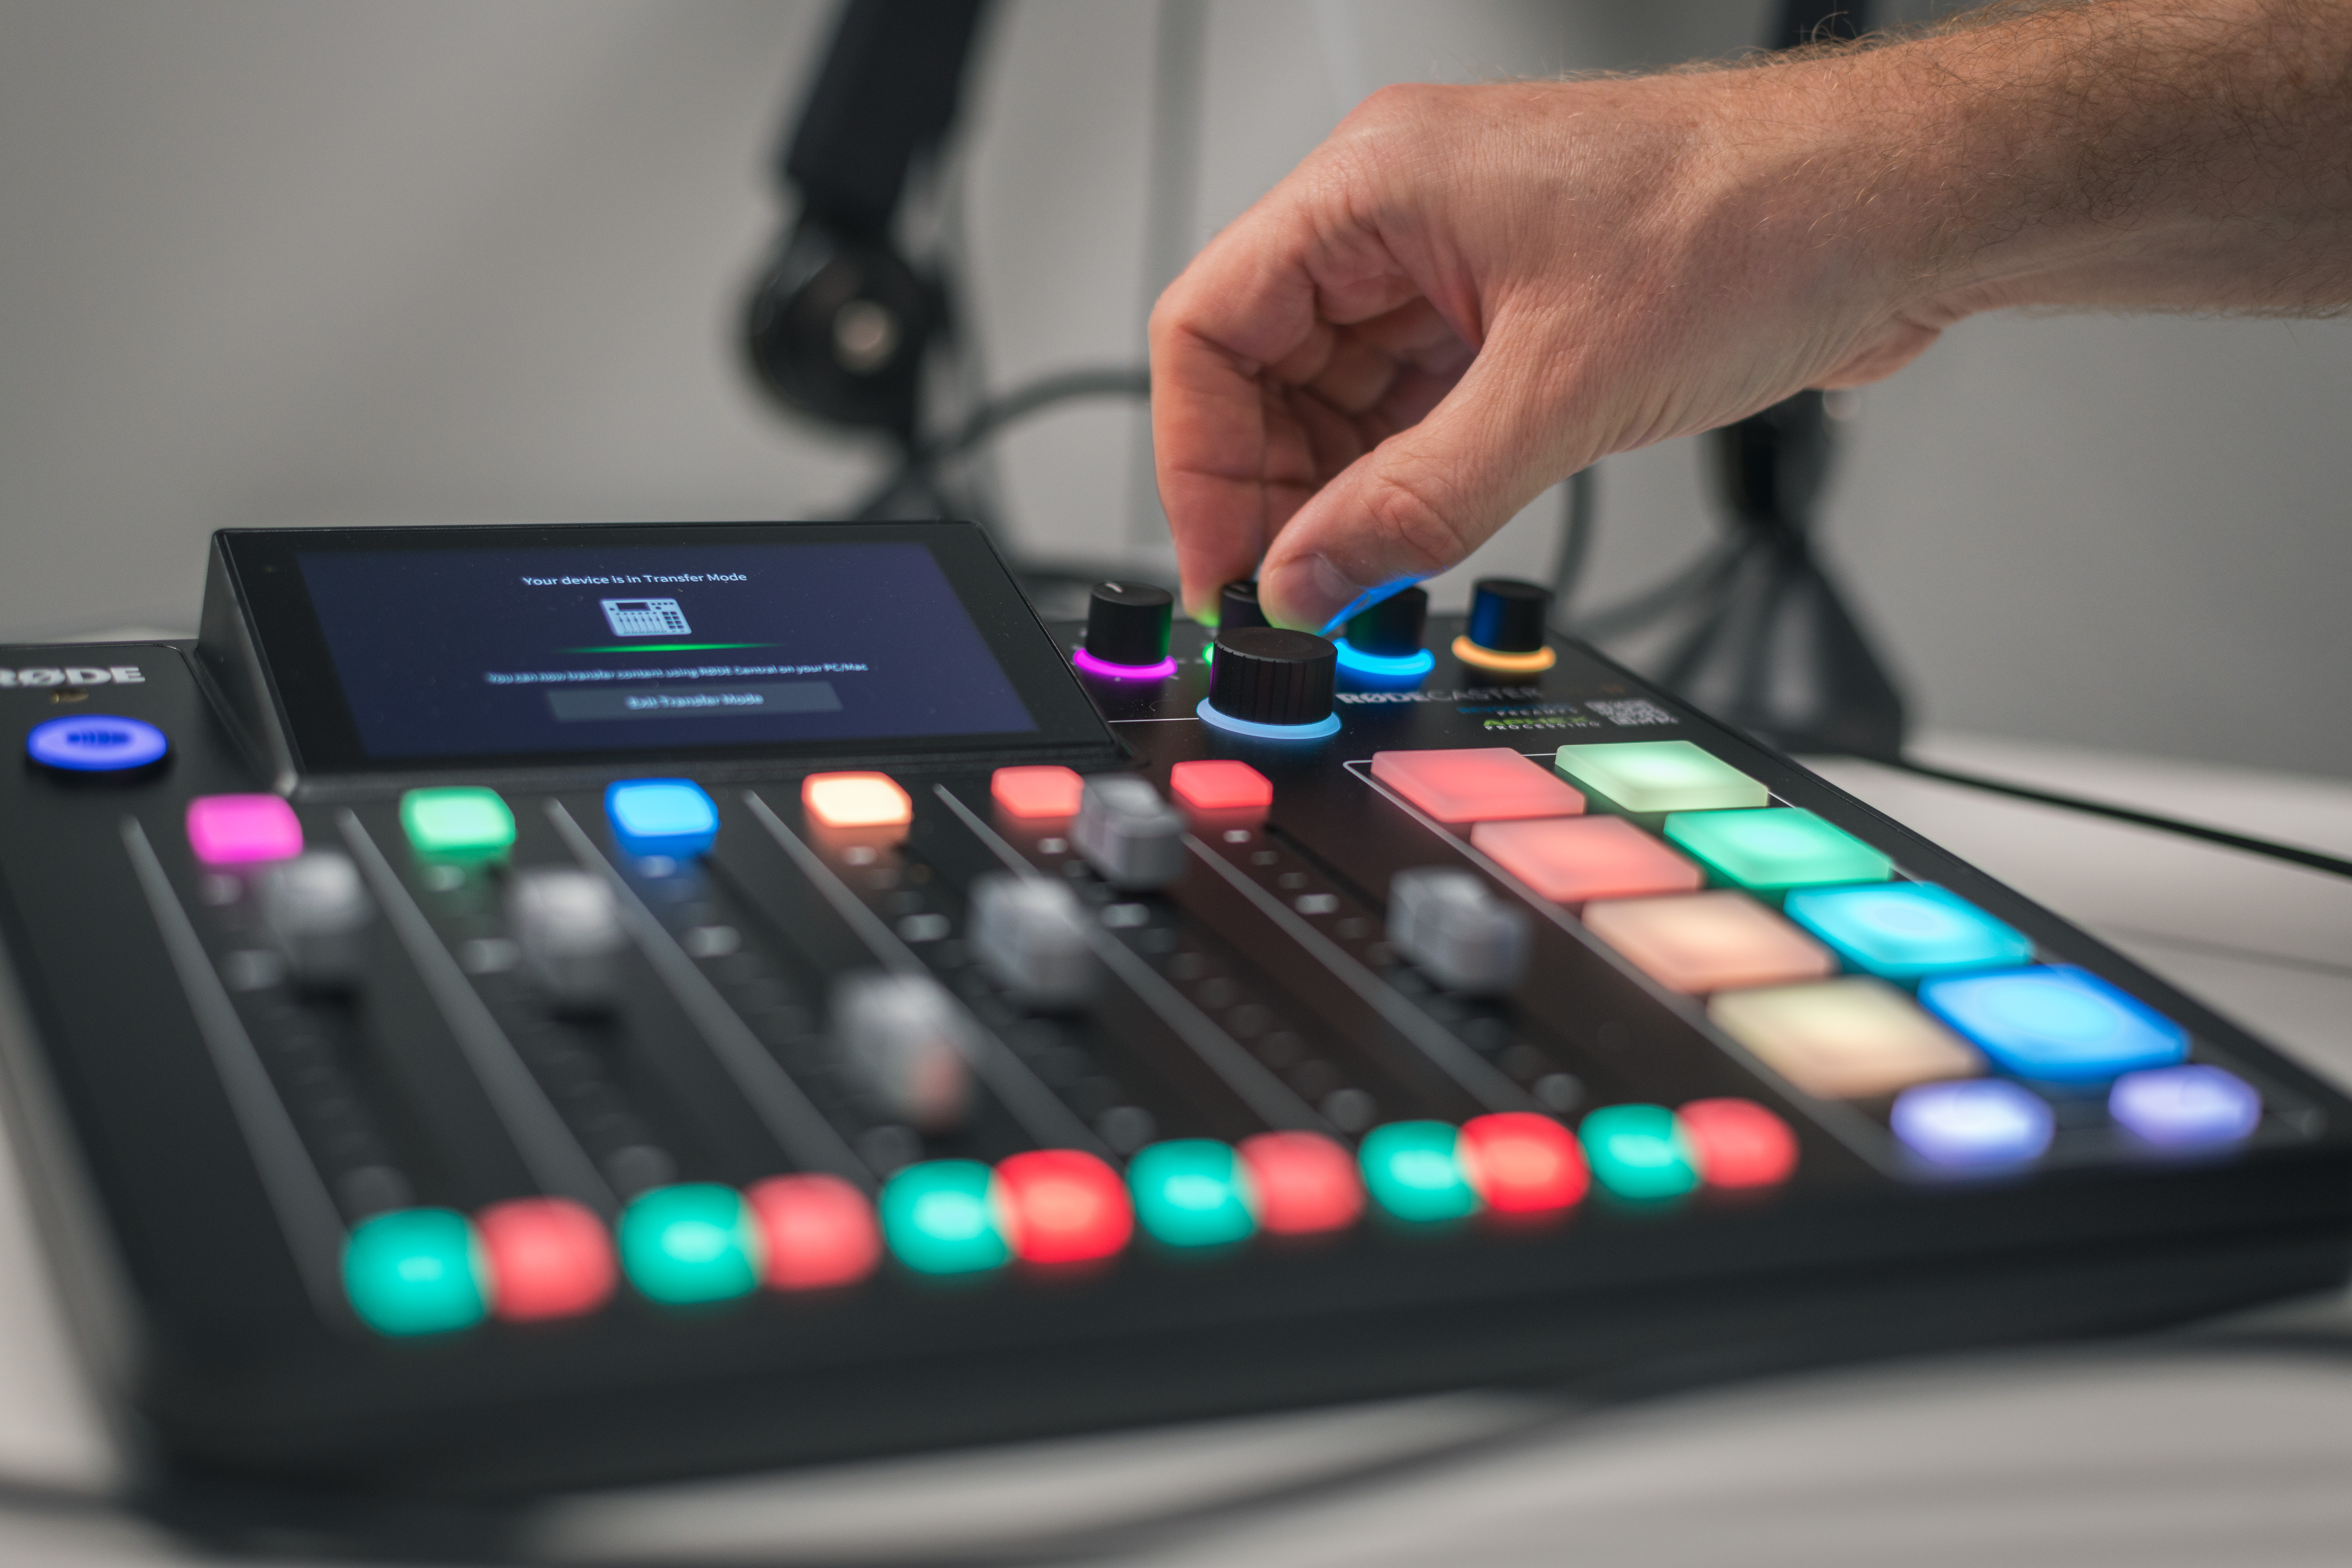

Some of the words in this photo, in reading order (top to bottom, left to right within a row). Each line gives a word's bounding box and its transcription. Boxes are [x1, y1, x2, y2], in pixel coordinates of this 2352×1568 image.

[523, 576, 558, 585] Your
[562, 576, 609, 585] device
[611, 575, 625, 583] is
[626, 575, 642, 583] in
[643, 573, 704, 583] Transfer
[706, 573, 747, 581] Mode
[733, 665, 778, 675] Central
[779, 666, 795, 674] on
[796, 665, 822, 675] your
[822, 662, 869, 673] PC/Mac
[659, 694, 720, 708] Transfer
[720, 692, 764, 706] Mode
[1484, 721, 1601, 730] PROCESSING
